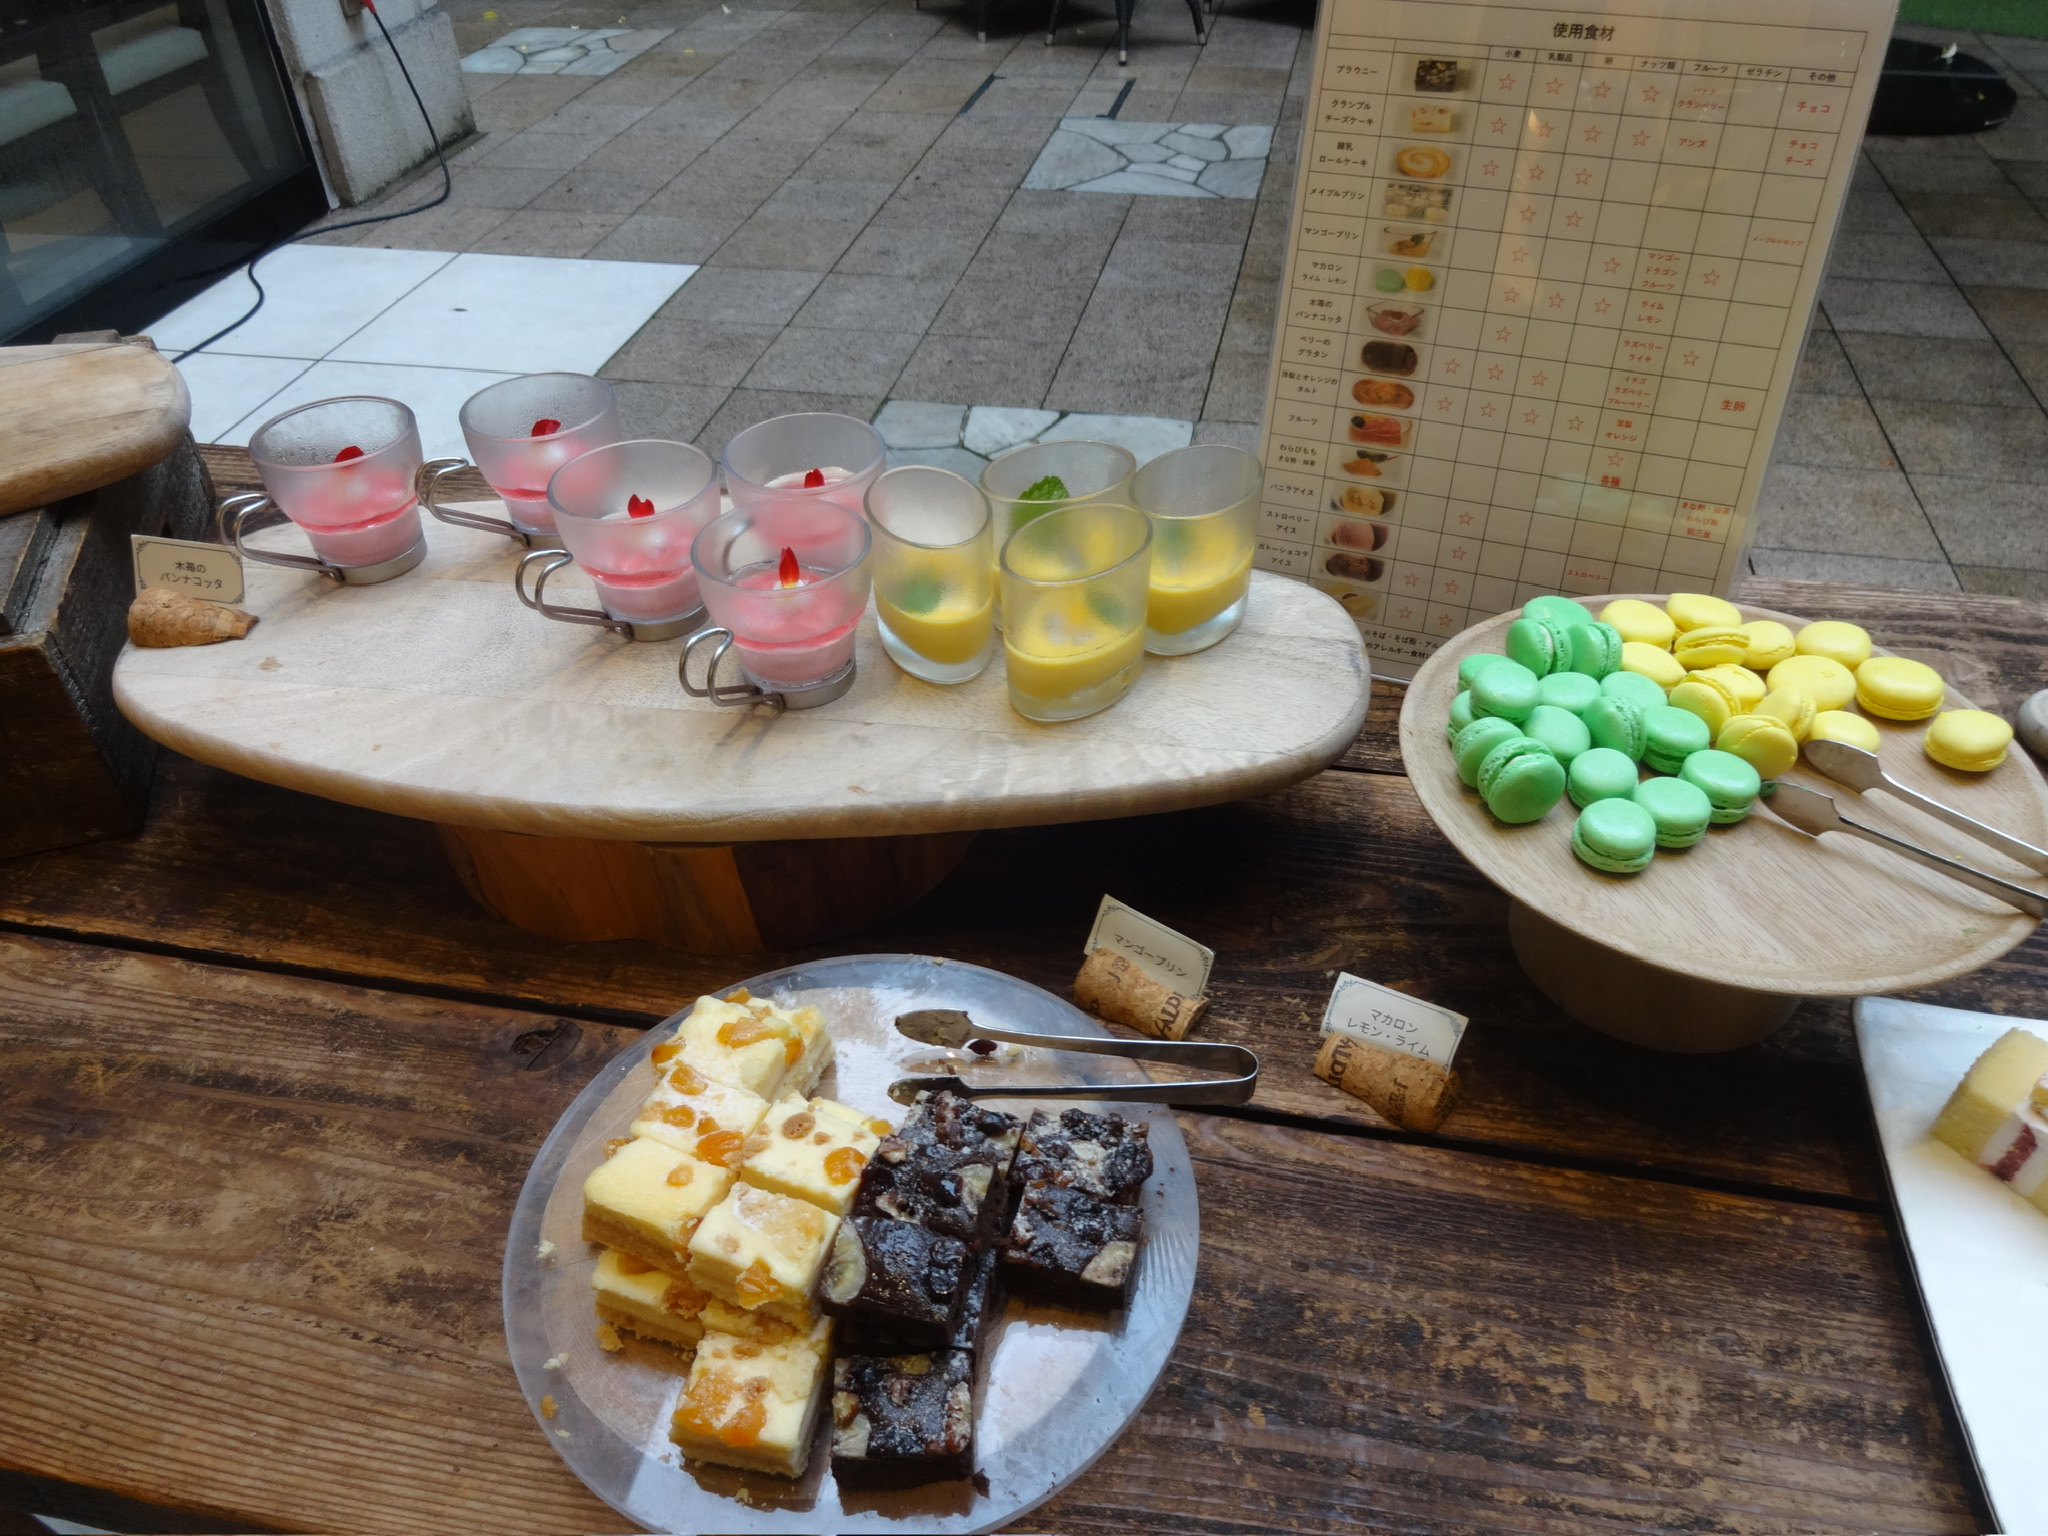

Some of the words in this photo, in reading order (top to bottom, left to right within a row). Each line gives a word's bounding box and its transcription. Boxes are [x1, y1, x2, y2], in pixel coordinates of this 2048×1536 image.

[1553, 22, 1616, 42] 使用食材
[1505, 49, 1521, 59] 小麦
[1548, 53, 1573, 63] 乳製品
[1336, 64, 1379, 76] ブラウニー
[1640, 60, 1676, 71] ナッツ類
[1694, 63, 1729, 73] フルーツ
[1746, 67, 1782, 78] ゼラチン
[1808, 72, 1836, 82] その他
[1331, 99, 1372, 111] クランブル
[1797, 101, 1831, 114] チョコ
[1325, 115, 1374, 126] チーズケーキ
[1678, 138, 1708, 149] アンズ
[1789, 140, 1819, 150] チョコ
[1318, 155, 1368, 168] ロールケーキ
[1785, 156, 1815, 167] チーズ
[1304, 227, 1360, 240] マンゴープリン
[1648, 252, 1681, 262] マンゴー
[1311, 261, 1343, 271] マカロン
[1645, 266, 1679, 277] ドラゴン
[1641, 280, 1675, 290] フルーツ
[1641, 301, 1665, 311] ライム
[1638, 314, 1662, 324] レモン
[1299, 335, 1331, 346] ベリーの
[1623, 339, 1663, 351] ラズベリー
[1298, 348, 1328, 359] グラタン
[1297, 385, 1317, 395] タルト
[1720, 399, 1746, 412] 生卵
[1288, 414, 1318, 425] フルーツ
[1605, 432, 1638, 442] オレンジ
[1279, 443, 1317, 456] わらびもち
[1601, 475, 1621, 487] 各種
[1266, 510, 1310, 523] ストロベリー
[1275, 524, 1297, 534] アイス
[1257, 543, 1309, 558] ガトーショコラ
[175, 560, 207, 574] 木苺の
[1270, 557, 1292, 567] アイス
[160, 572, 224, 589] パンナコッタ
[1113, 933, 1188, 977] マンゴープリン
[1371, 1008, 1419, 1033] マカロン
[1347, 1017, 1430, 1057] レモン・ライム
